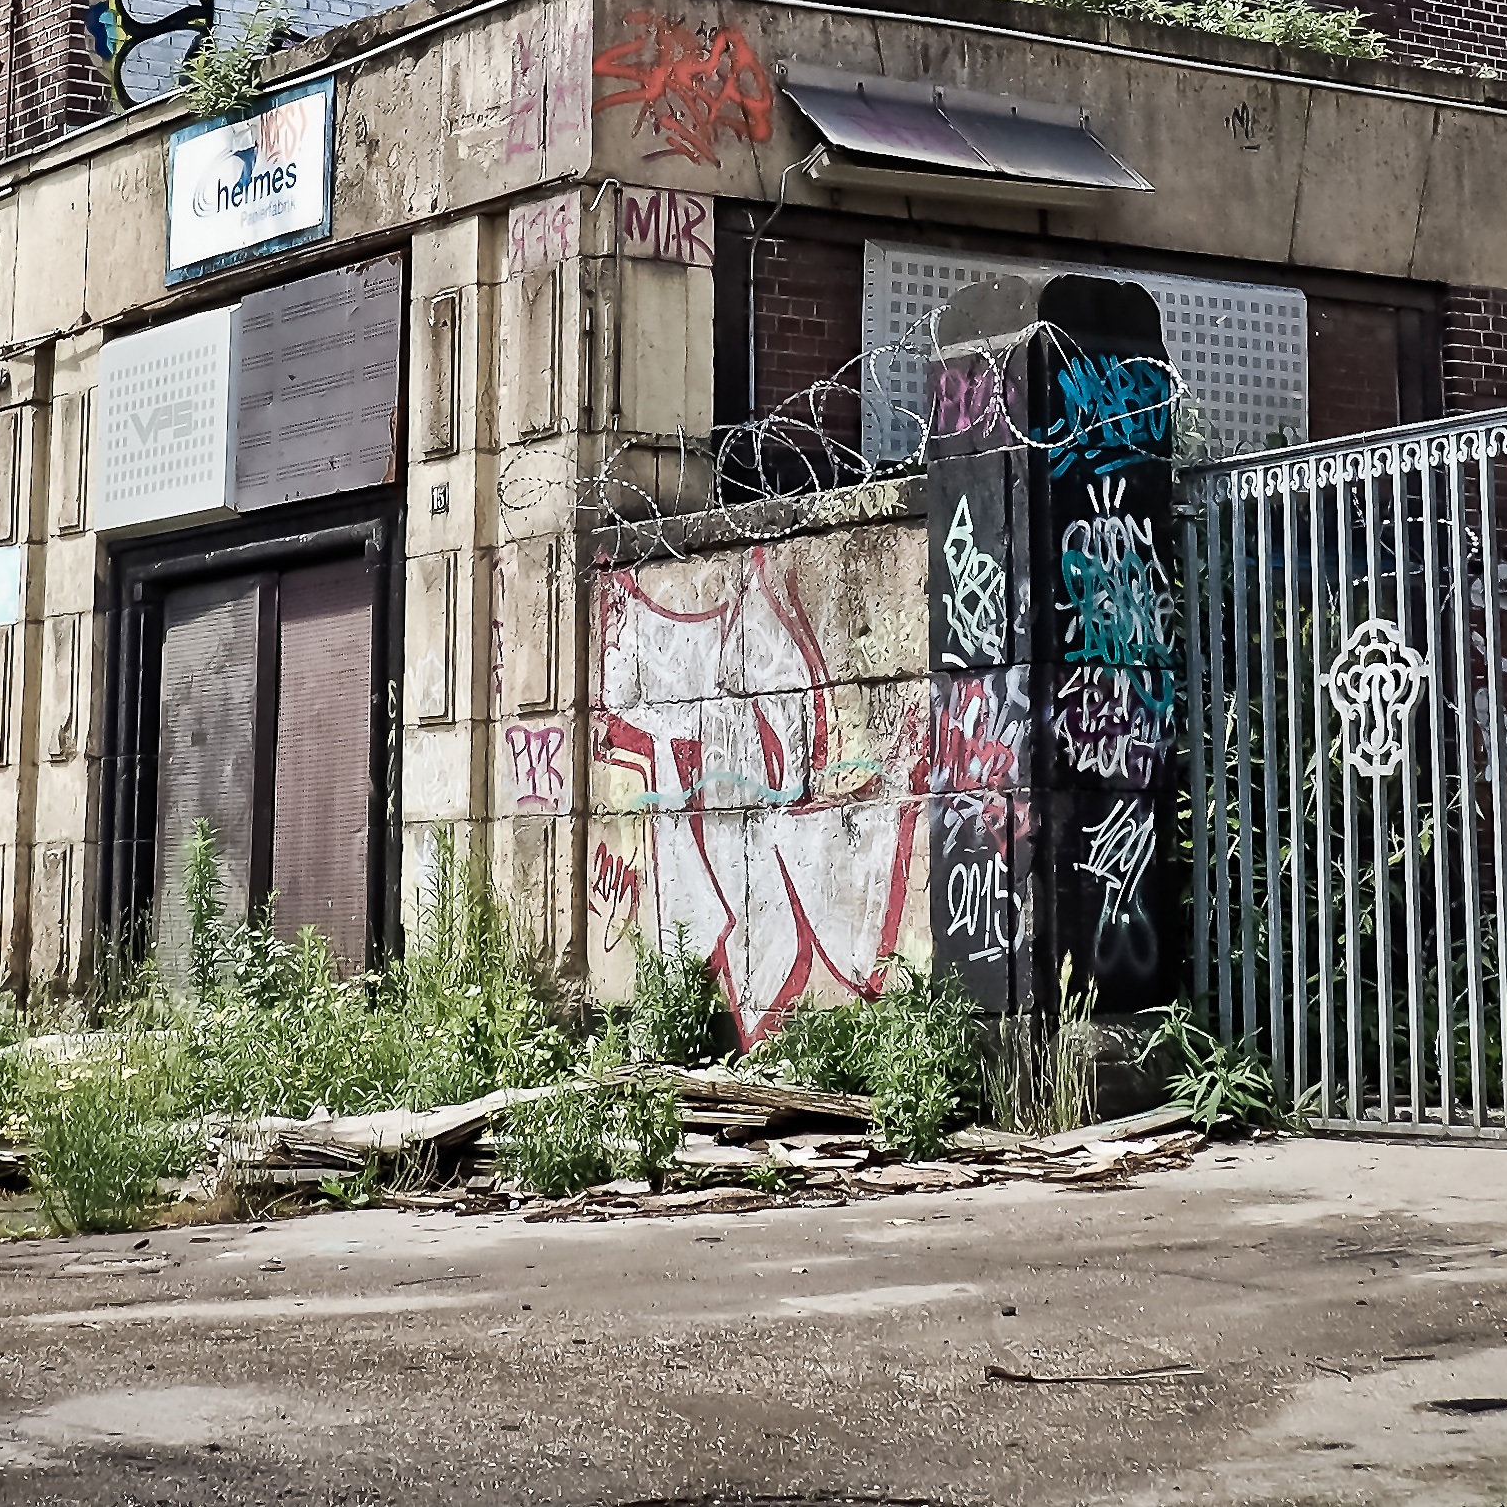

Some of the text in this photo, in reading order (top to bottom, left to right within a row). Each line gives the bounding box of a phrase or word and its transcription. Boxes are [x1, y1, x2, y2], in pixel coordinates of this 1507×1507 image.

[216, 161, 298, 213] hermes
[625, 190, 715, 267] MAR
[130, 400, 193, 447] VPS
[433, 487, 445, 510] 15
[947, 851, 1026, 954] 2015
